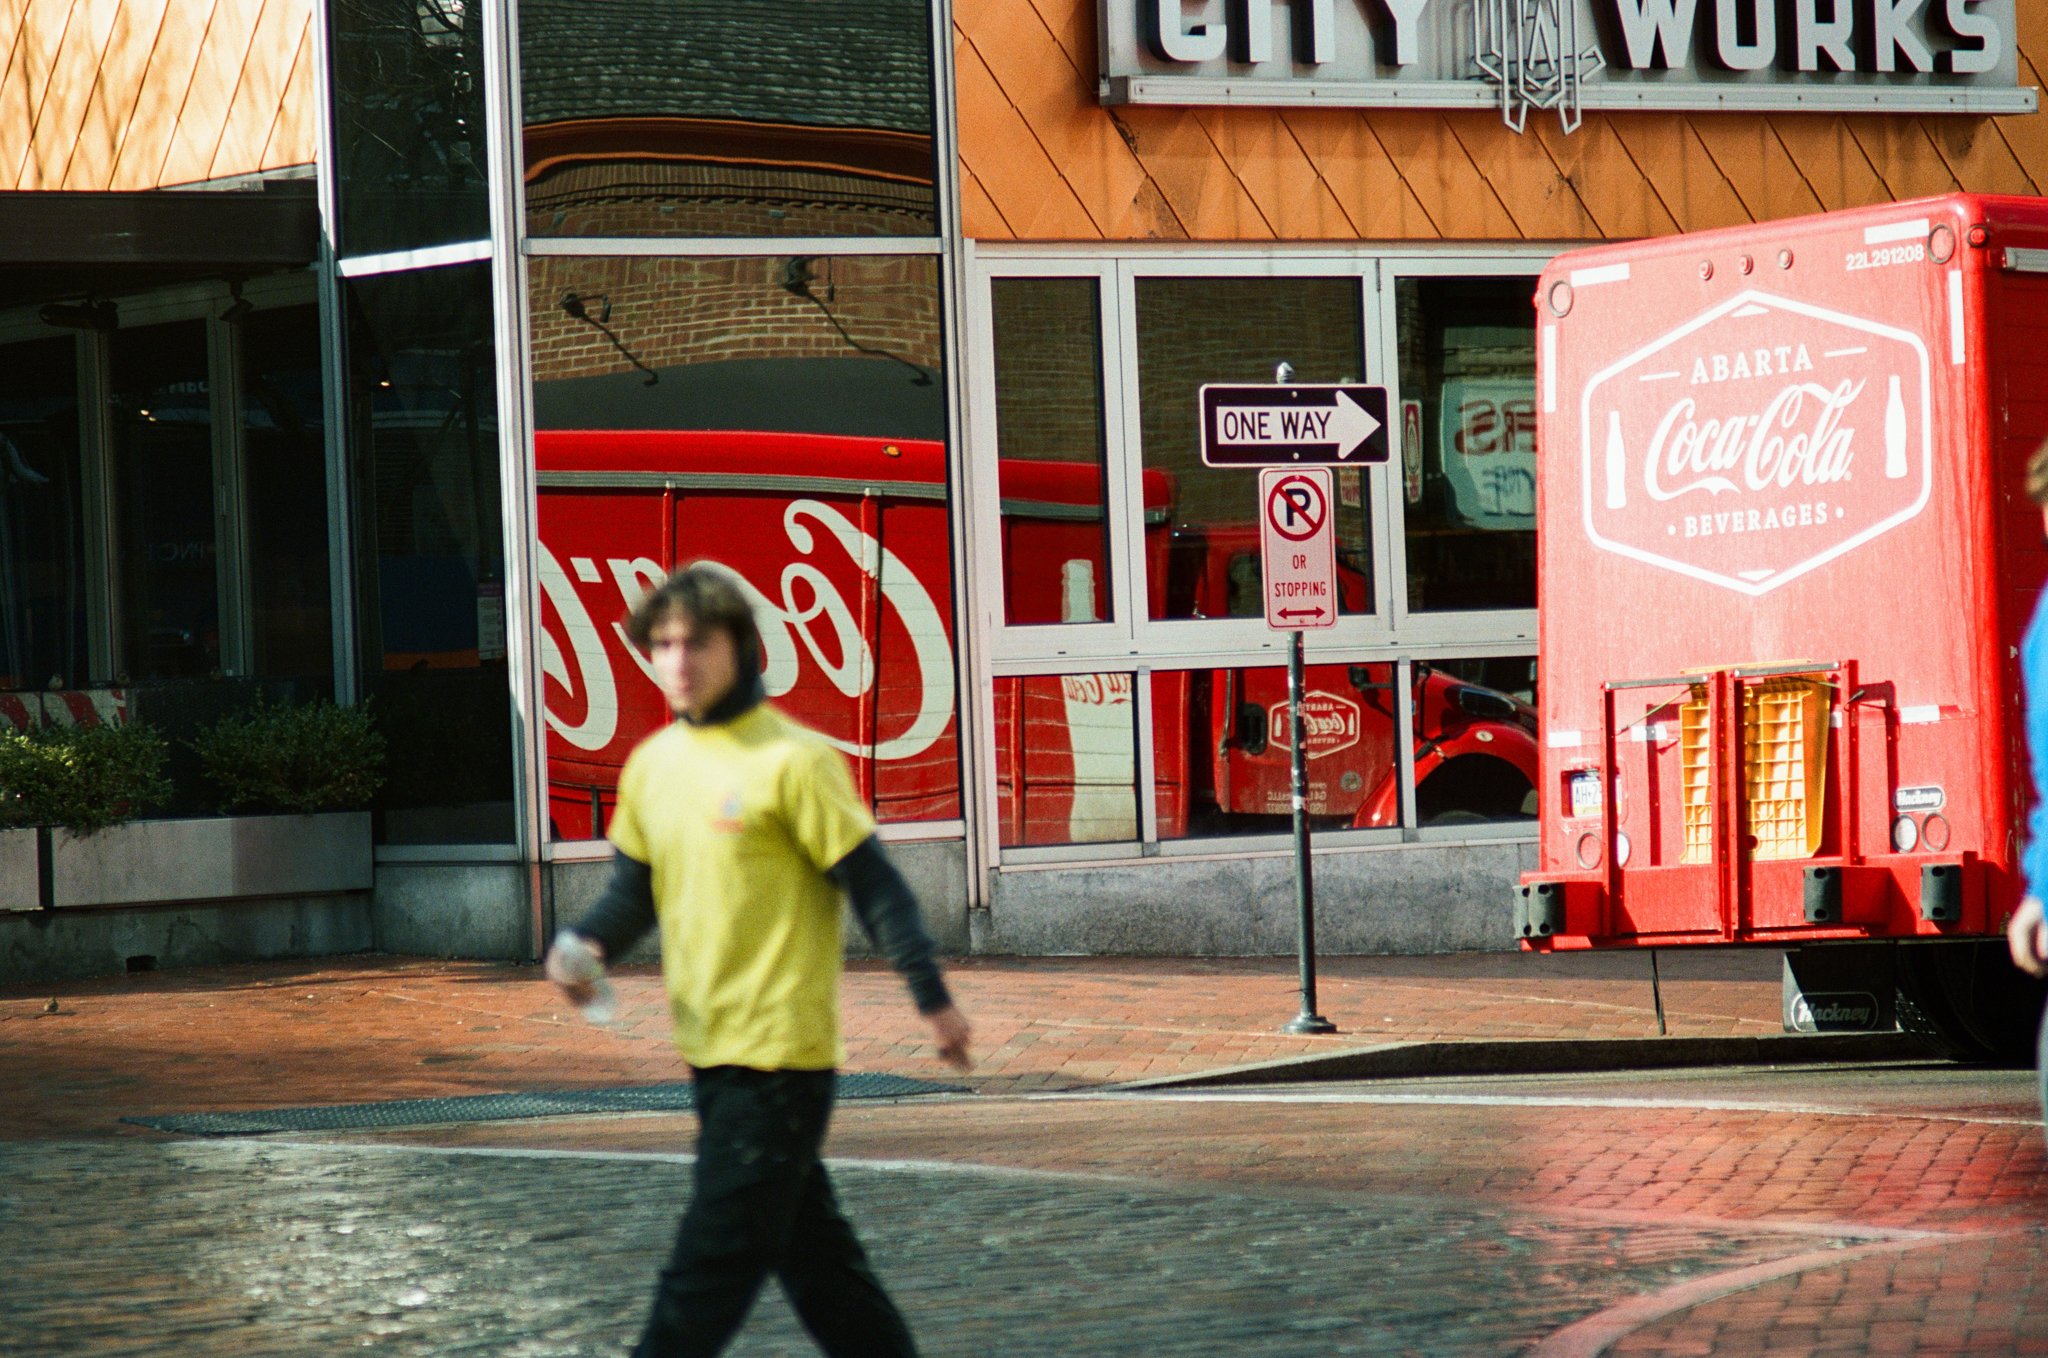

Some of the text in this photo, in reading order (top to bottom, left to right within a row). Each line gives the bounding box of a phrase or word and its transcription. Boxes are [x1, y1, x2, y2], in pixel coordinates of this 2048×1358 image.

[1158, 0, 2000, 73] CITY WORKS
[1845, 243, 1925, 271] 22L291208
[1690, 344, 1813, 386] ABARTA
[1223, 411, 1333, 441] ONE WAY
[1644, 377, 1867, 501] Coca-Cola
[1285, 488, 1312, 527] P
[1684, 502, 1828, 538] BEVERAGES
[1292, 554, 1307, 570] OR
[1274, 581, 1327, 598] STOPPING
[1799, 1003, 1871, 1025] Hackney
